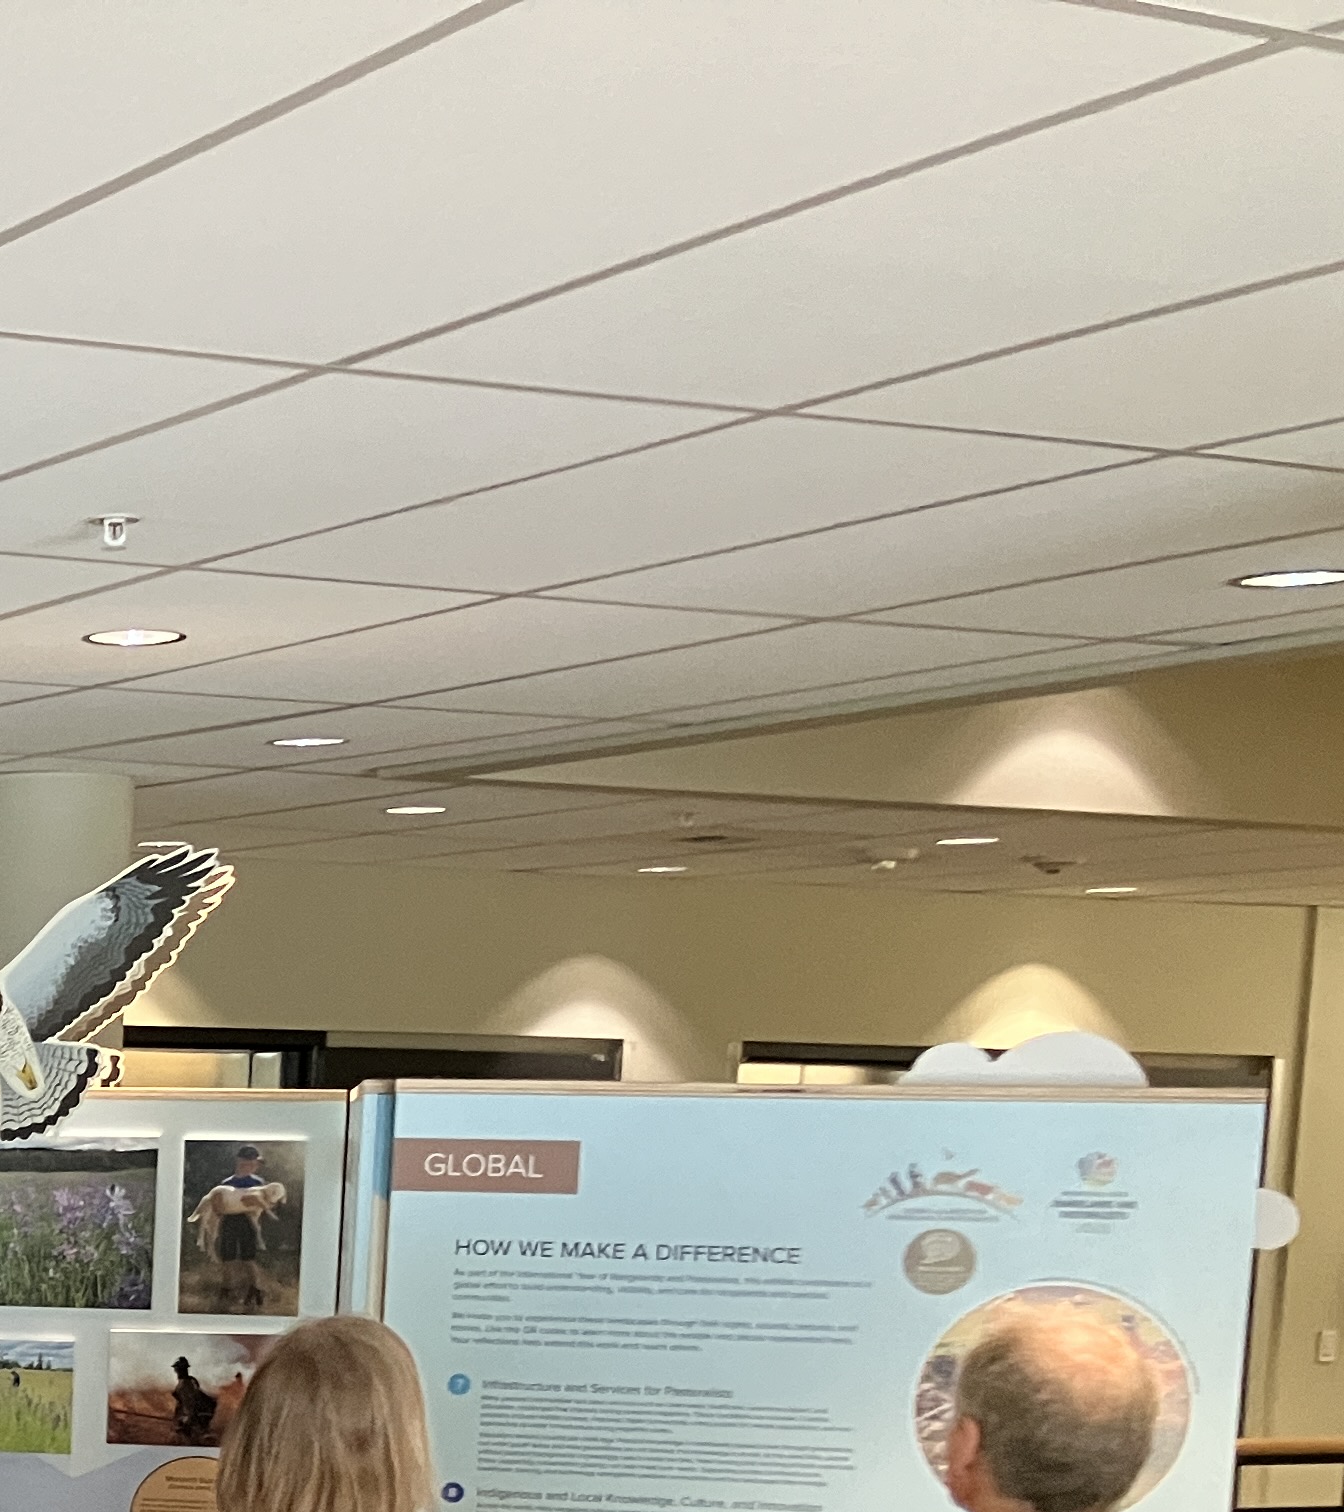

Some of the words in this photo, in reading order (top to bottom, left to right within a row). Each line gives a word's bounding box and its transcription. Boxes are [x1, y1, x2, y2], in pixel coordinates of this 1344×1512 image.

[424, 1152, 544, 1178] GLOBAL
[454, 1238, 512, 1256] HOW
[518, 1240, 553, 1257] WE
[560, 1242, 625, 1260] MAKE
[632, 1244, 649, 1261] A
[655, 1244, 802, 1264] DIFFERENCE
